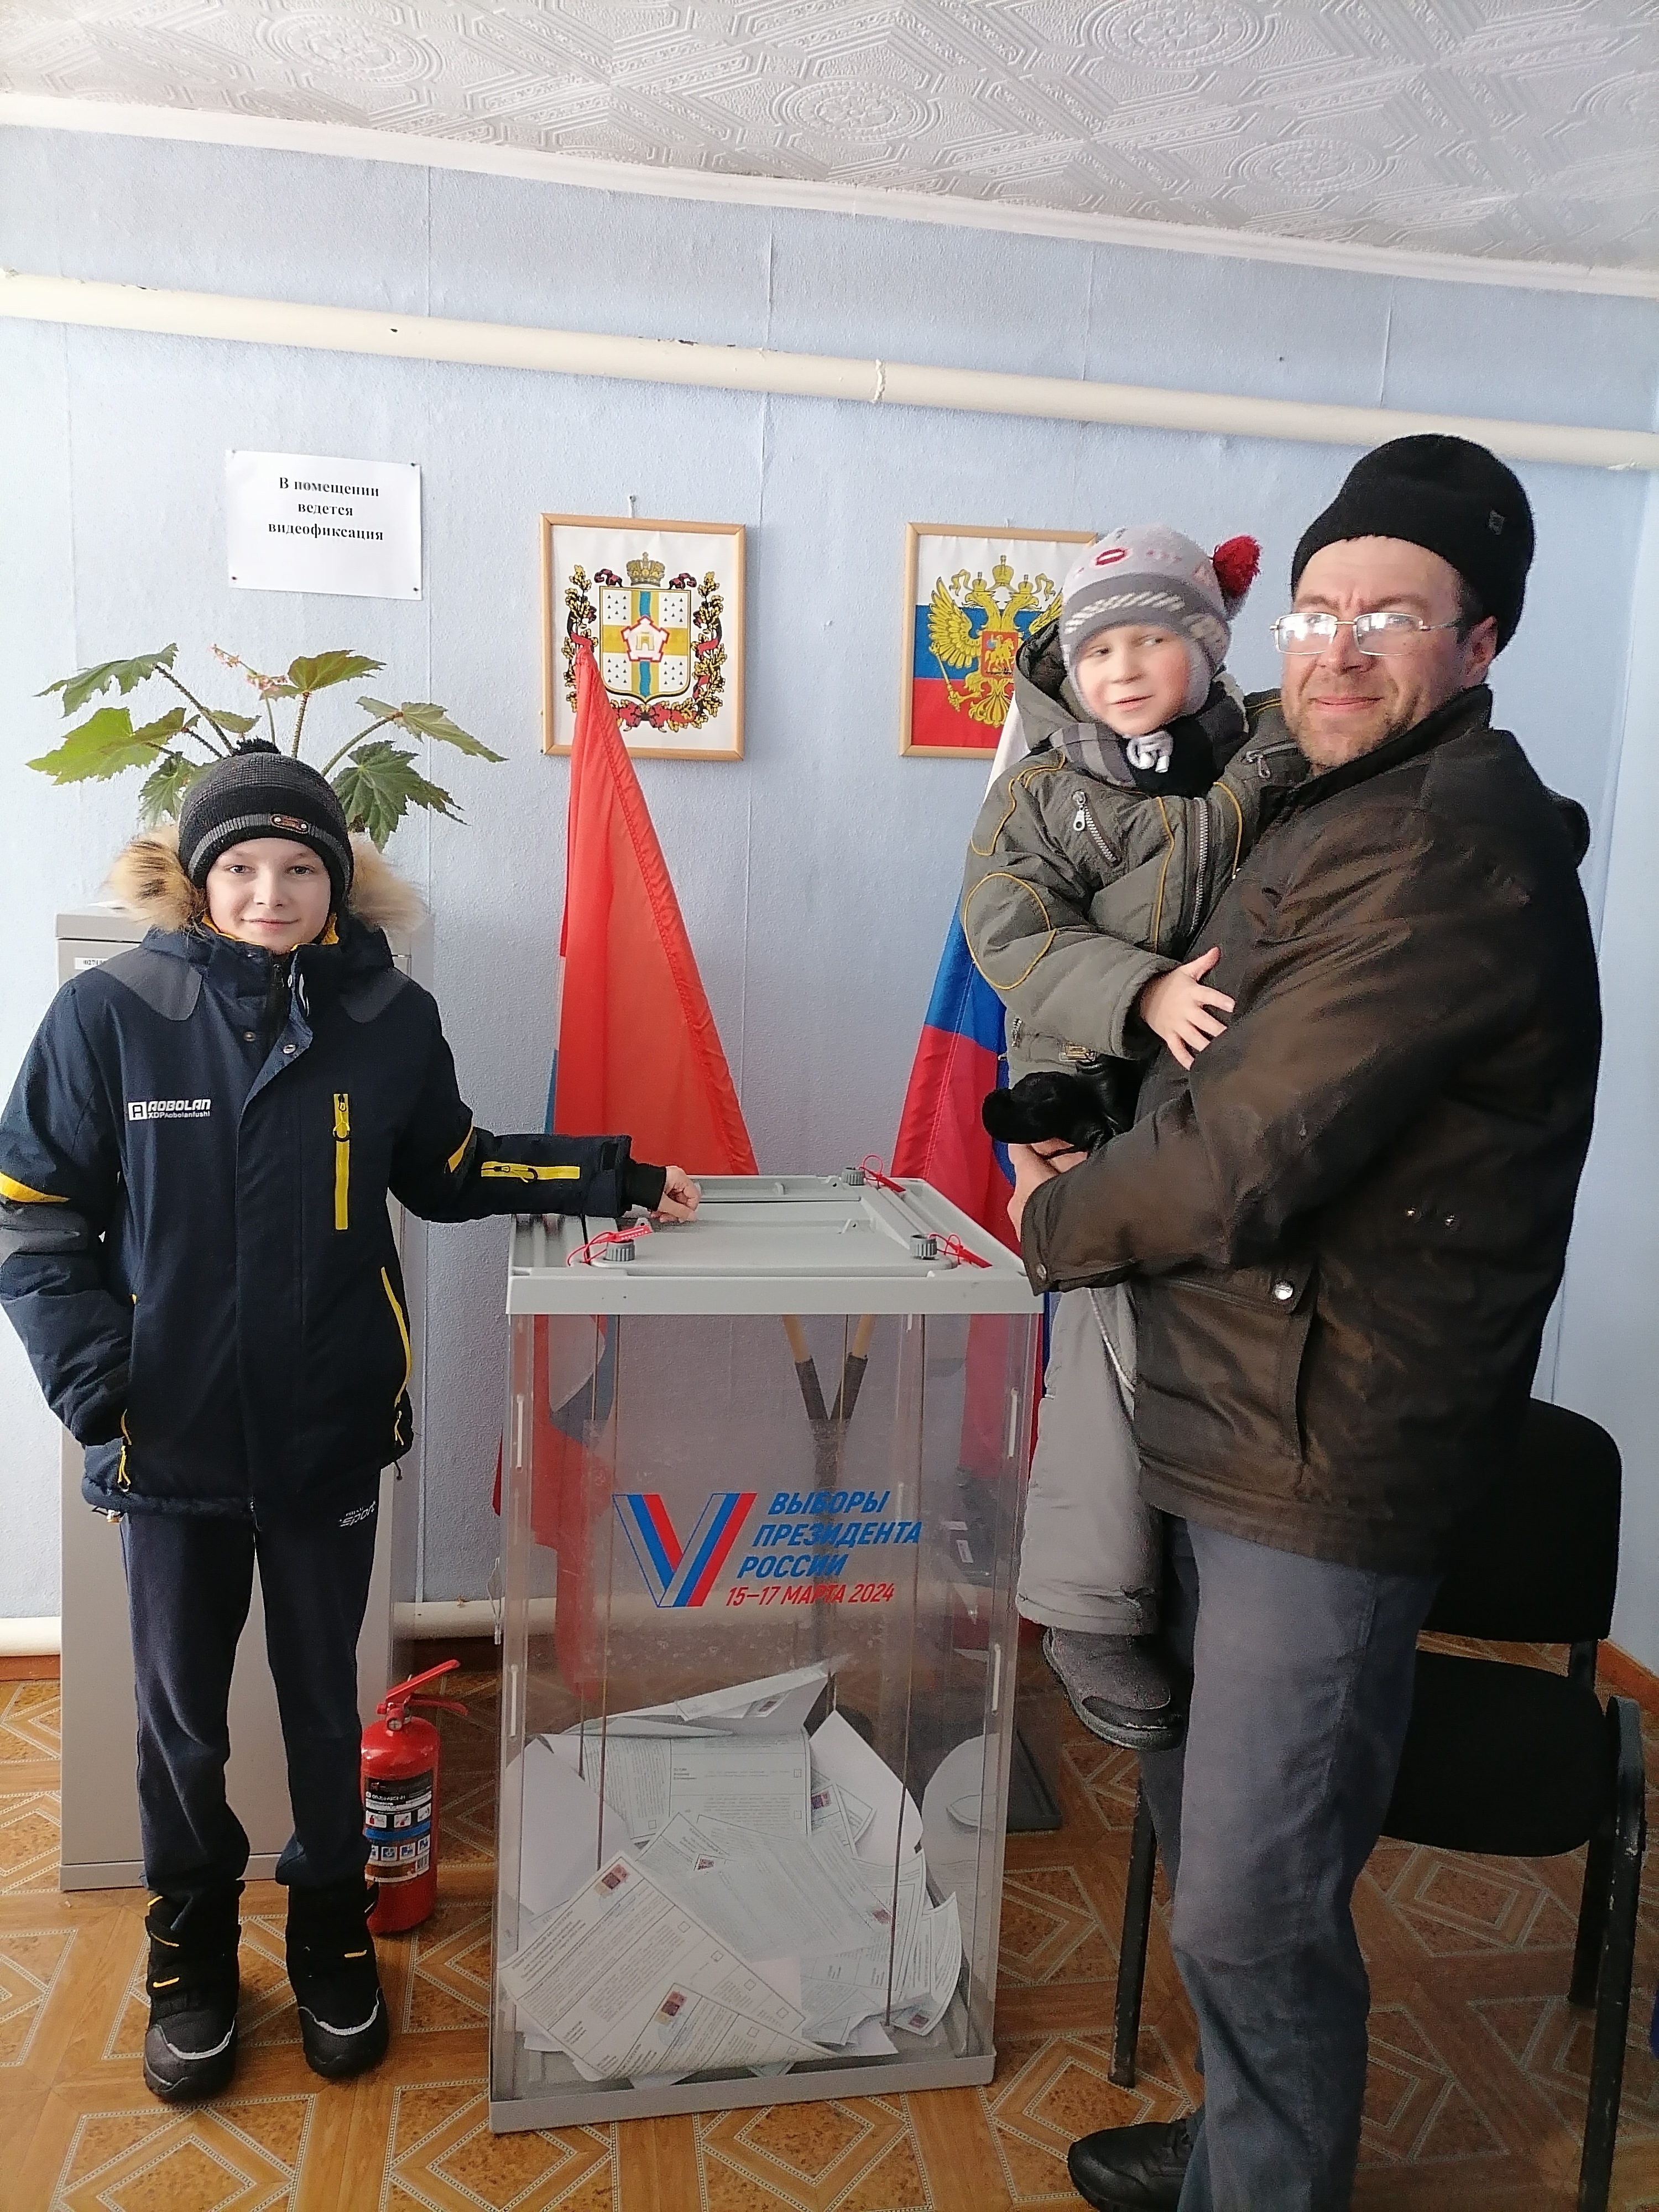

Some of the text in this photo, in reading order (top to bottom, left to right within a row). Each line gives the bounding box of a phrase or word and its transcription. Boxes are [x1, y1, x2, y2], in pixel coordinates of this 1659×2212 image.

[280, 477, 379, 497] В помещении
[298, 504, 353, 517] ведется
[268, 523, 383, 540] видеофиксация
[768, 1490, 890, 1515] ВЫБОРЫ
[753, 1521, 922, 1547] ПРЕЗИДЕНТА
[737, 1554, 848, 1579] РОССИИ
[781, 1584, 846, 1605] МАРТА
[848, 1583, 895, 1603] 2024
